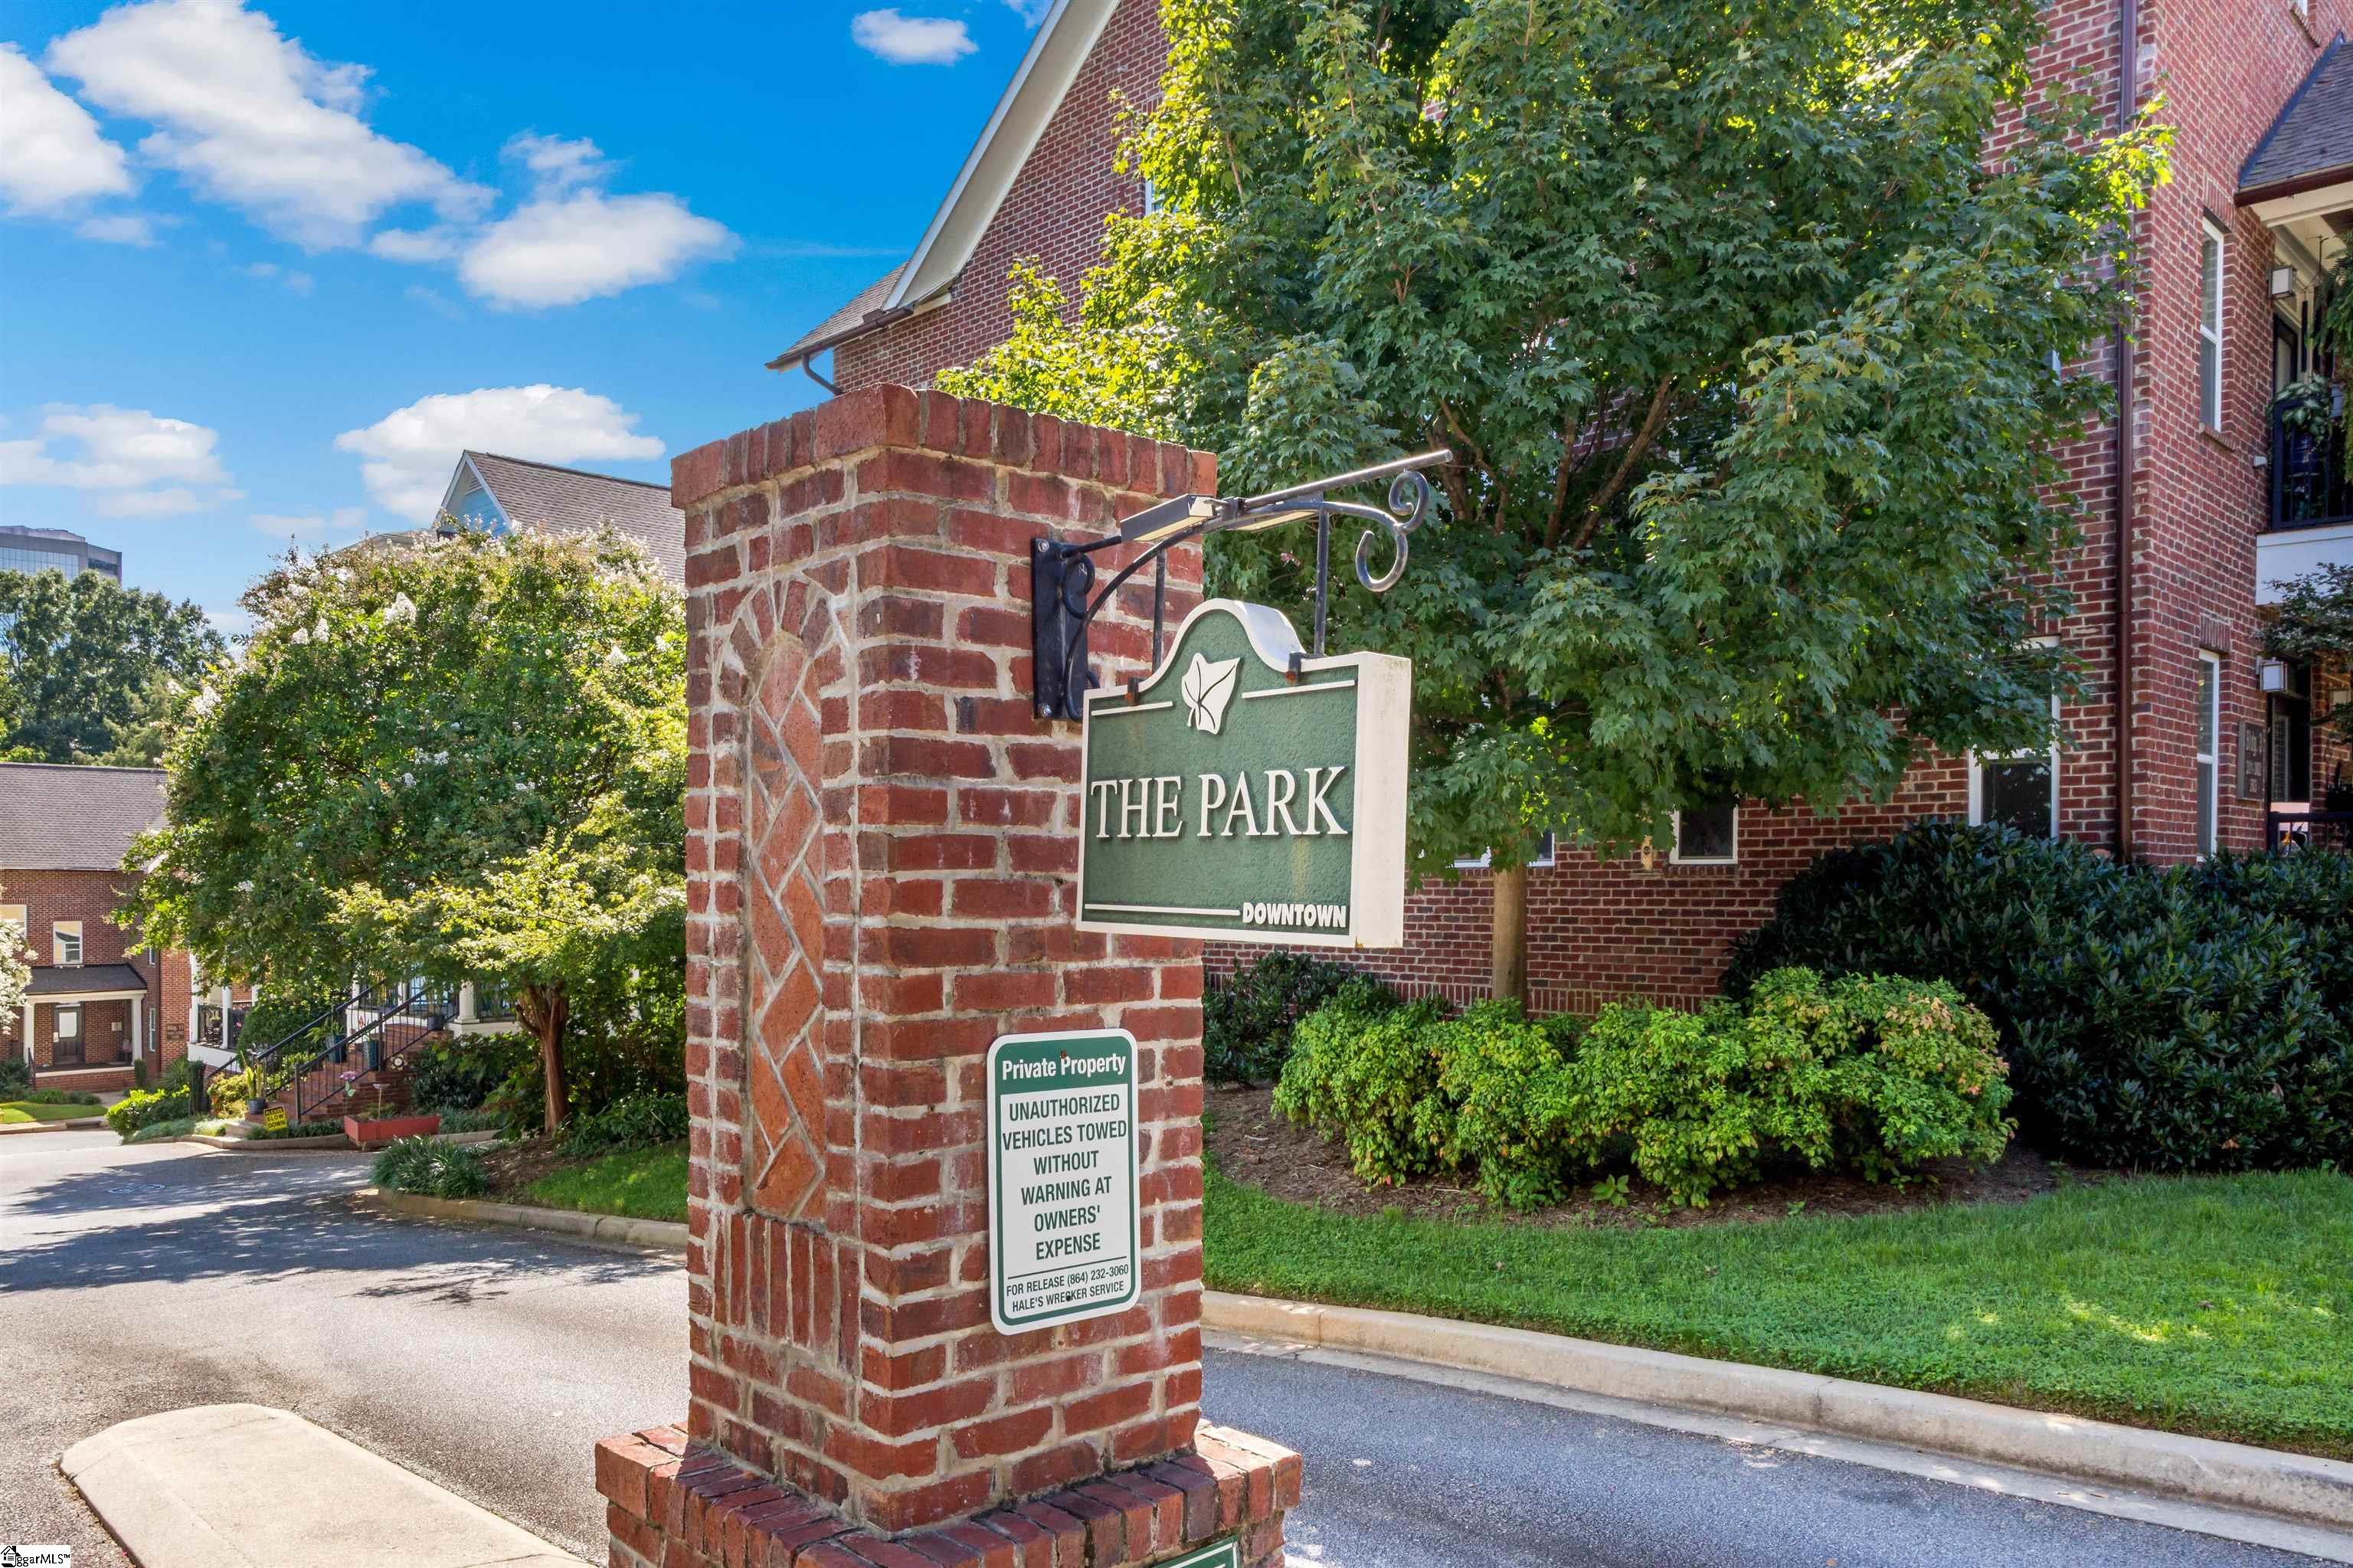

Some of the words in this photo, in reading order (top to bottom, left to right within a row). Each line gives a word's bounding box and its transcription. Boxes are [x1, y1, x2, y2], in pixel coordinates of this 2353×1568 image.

[1091, 776, 1183, 838] THE
[1196, 766, 1348, 836] PARK
[1242, 902, 1347, 928] DOWNTOWN
[1003, 1058, 1056, 1080] Private
[1060, 1052, 1126, 1078] Property
[1010, 1093, 1120, 1121] UNAUTHORIZED
[1003, 1125, 1072, 1151] VEHICLES
[1077, 1120, 1127, 1142] TOWED
[1034, 1151, 1099, 1175] WITHOUT
[1021, 1179, 1091, 1205] WARNING
[1095, 1176, 1111, 1195] AT
[1034, 1205, 1100, 1232] OWNERS'
[1036, 1232, 1100, 1260] EXPENSE
[1006, 1283, 1023, 1296] FOR
[1027, 1275, 1065, 1291] RELEASE
[1067, 1271, 1088, 1287] (864)
[1091, 1264, 1128, 1281] 232-3060
[1013, 1295, 1043, 1312] HALE'S
[1090, 1281, 1124, 1297] SERVICE
